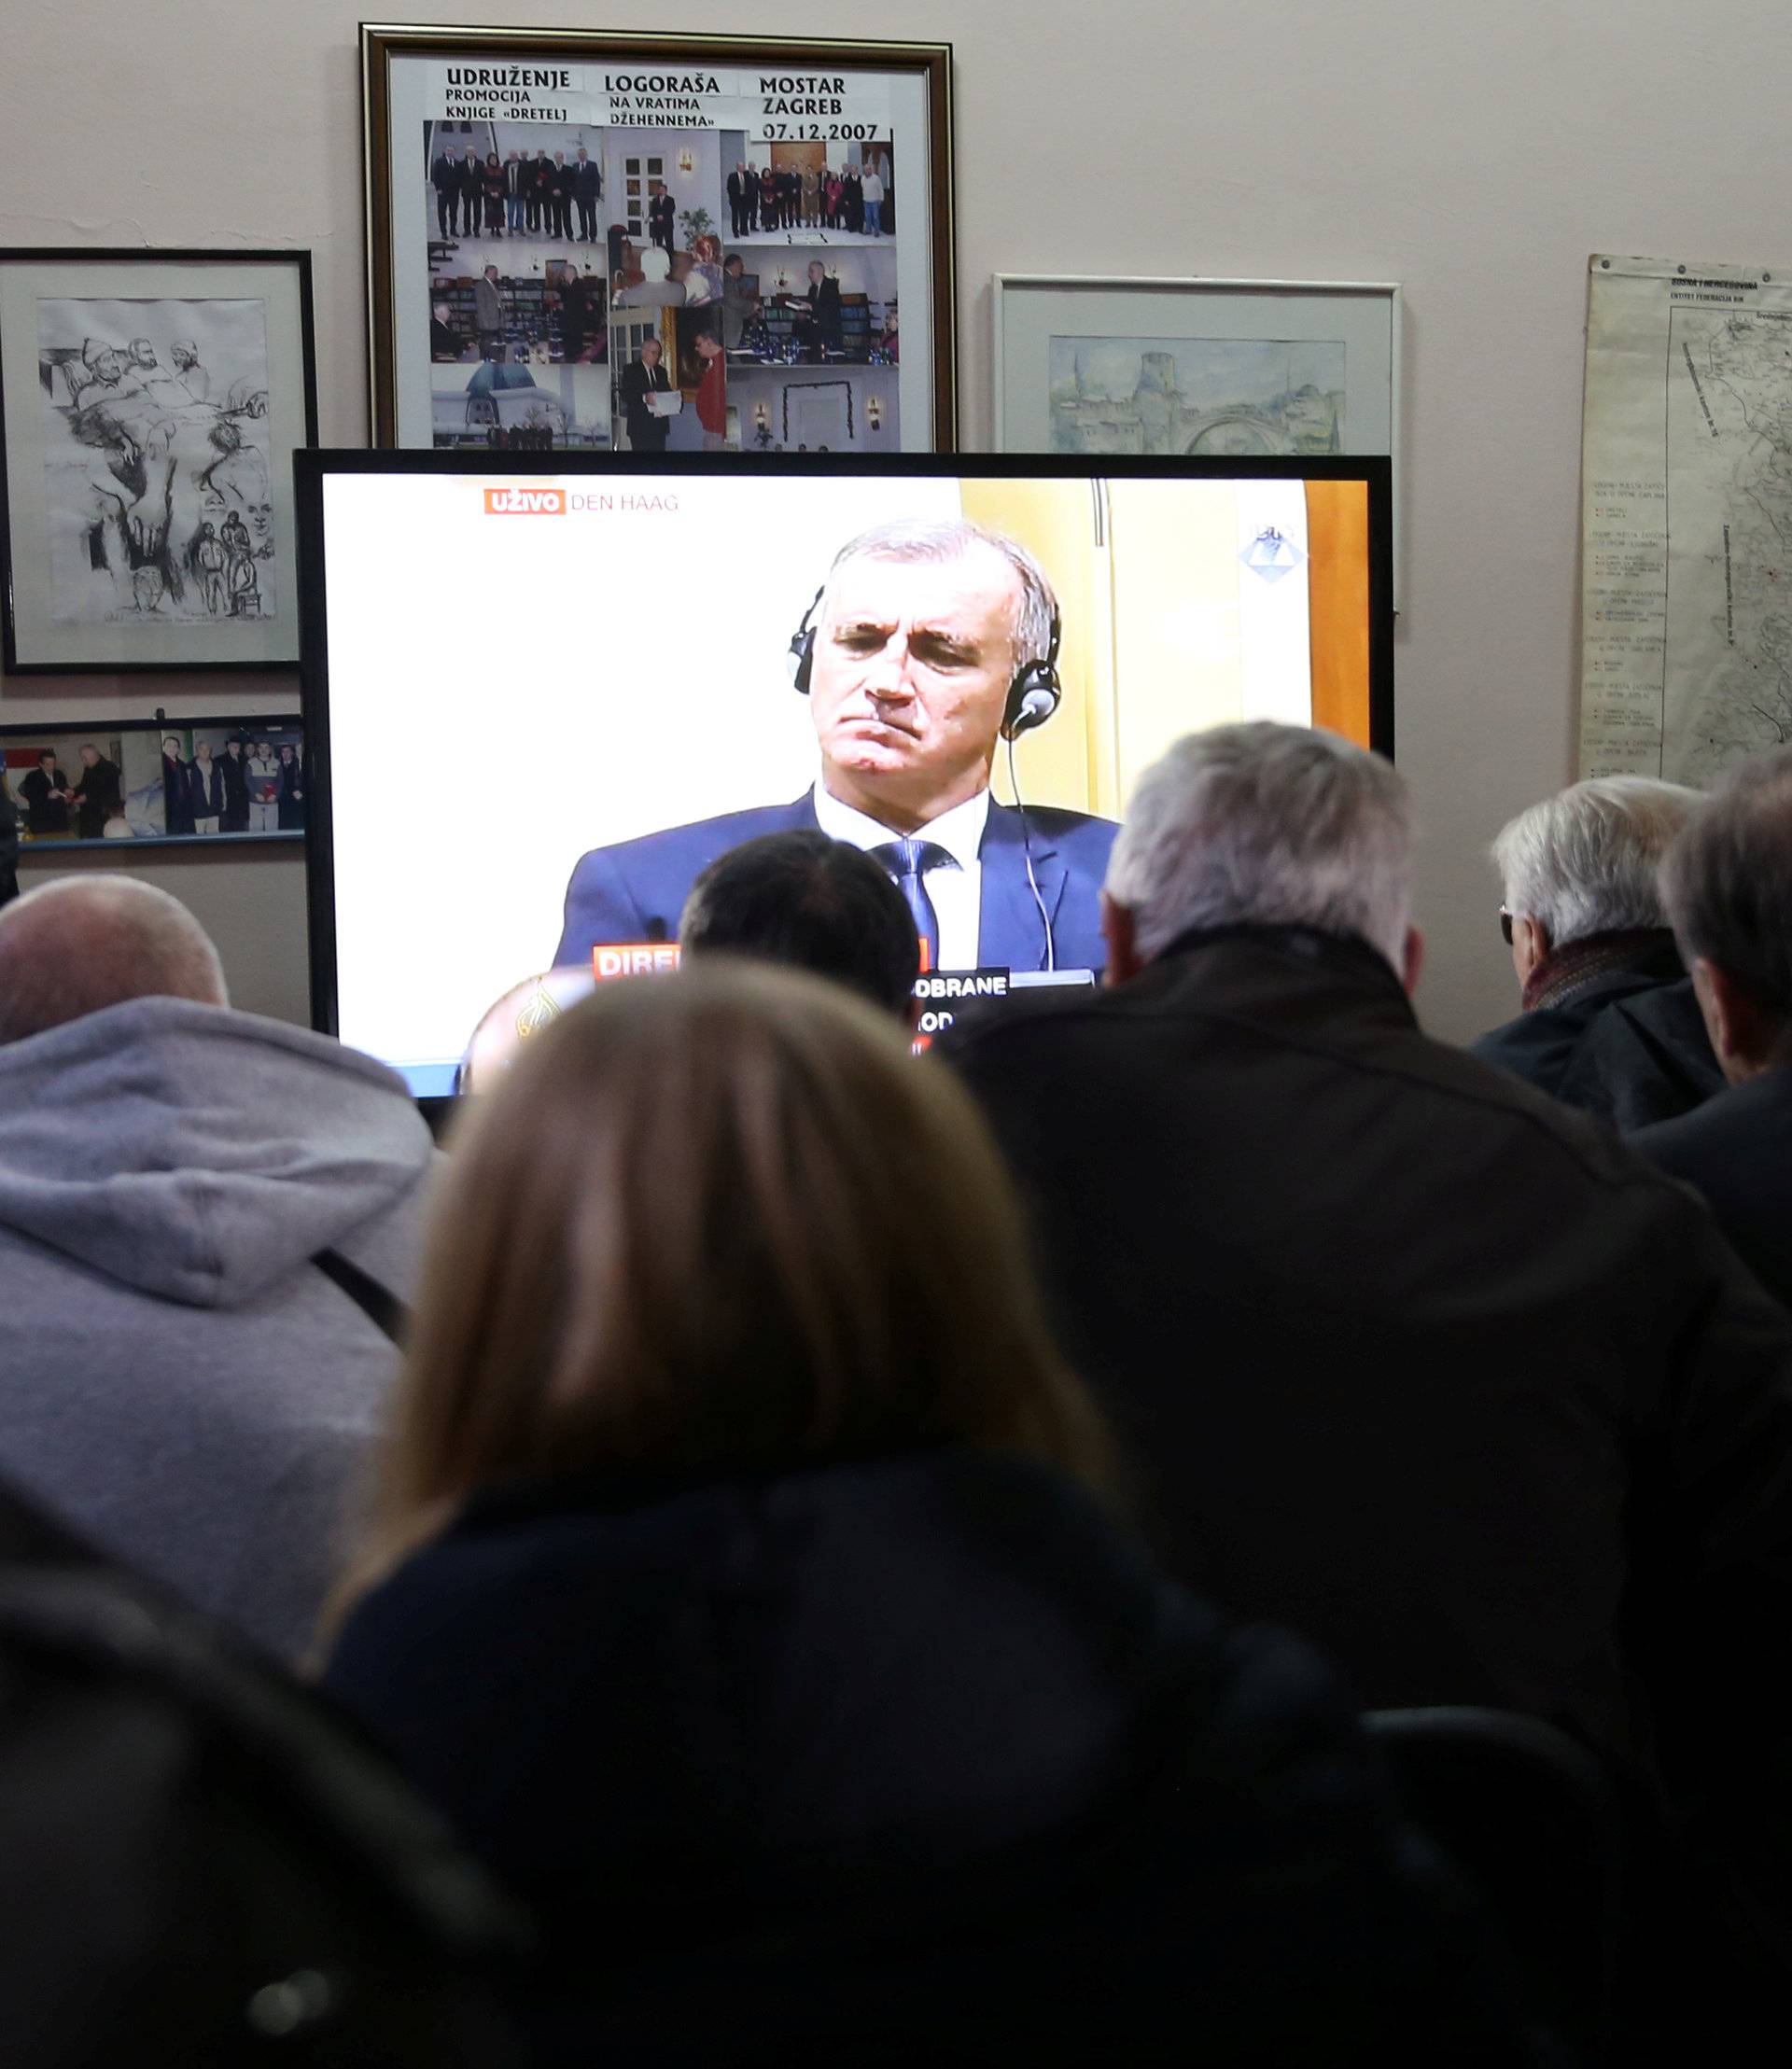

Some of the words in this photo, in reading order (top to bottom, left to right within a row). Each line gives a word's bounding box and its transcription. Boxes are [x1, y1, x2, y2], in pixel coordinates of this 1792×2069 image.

[446, 65, 570, 90] UDRUŽENJE
[605, 72, 721, 93] LOGORAŠA
[759, 77, 846, 94] MOSTAR
[446, 89, 531, 104] PROMOCIJA
[609, 96, 631, 108] NA
[636, 97, 700, 110] VRATIMA
[446, 105, 496, 120] KNJIGE
[503, 107, 567, 121] «DRETELJ
[763, 97, 843, 115] ZAGREB
[610, 111, 715, 127] DŽEHENNEMA»
[762, 123, 878, 140] 07.12.2007
[491, 487, 561, 512] UŽIVO
[571, 495, 613, 510] DEN
[621, 495, 679, 511] HAAG
[598, 949, 681, 977] DIRE
[911, 976, 1007, 999] DBRANE
